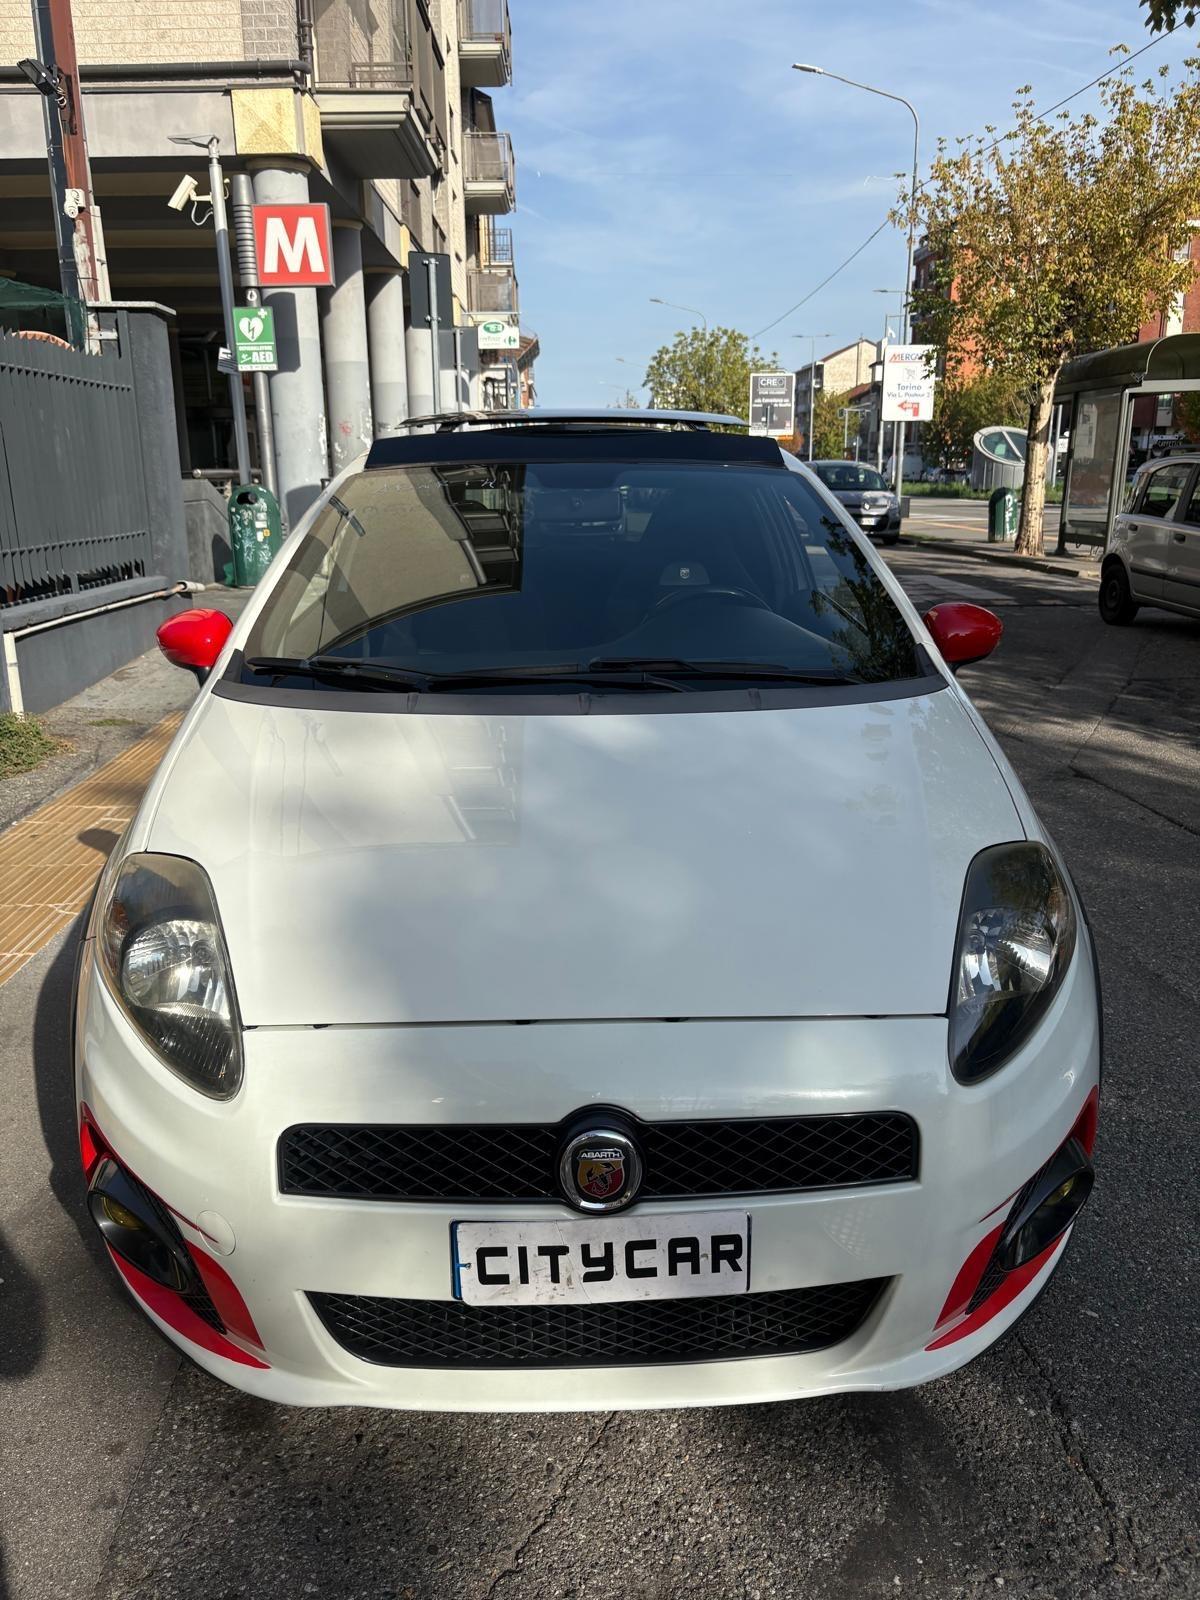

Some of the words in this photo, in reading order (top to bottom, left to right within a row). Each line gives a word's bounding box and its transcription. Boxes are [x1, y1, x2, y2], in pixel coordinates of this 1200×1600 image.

[263, 216, 326, 274] M
[251, 351, 274, 363] AED
[889, 353, 925, 362] MERCA
[897, 383, 922, 391] Torino
[475, 1233, 743, 1286] CITYCAR
